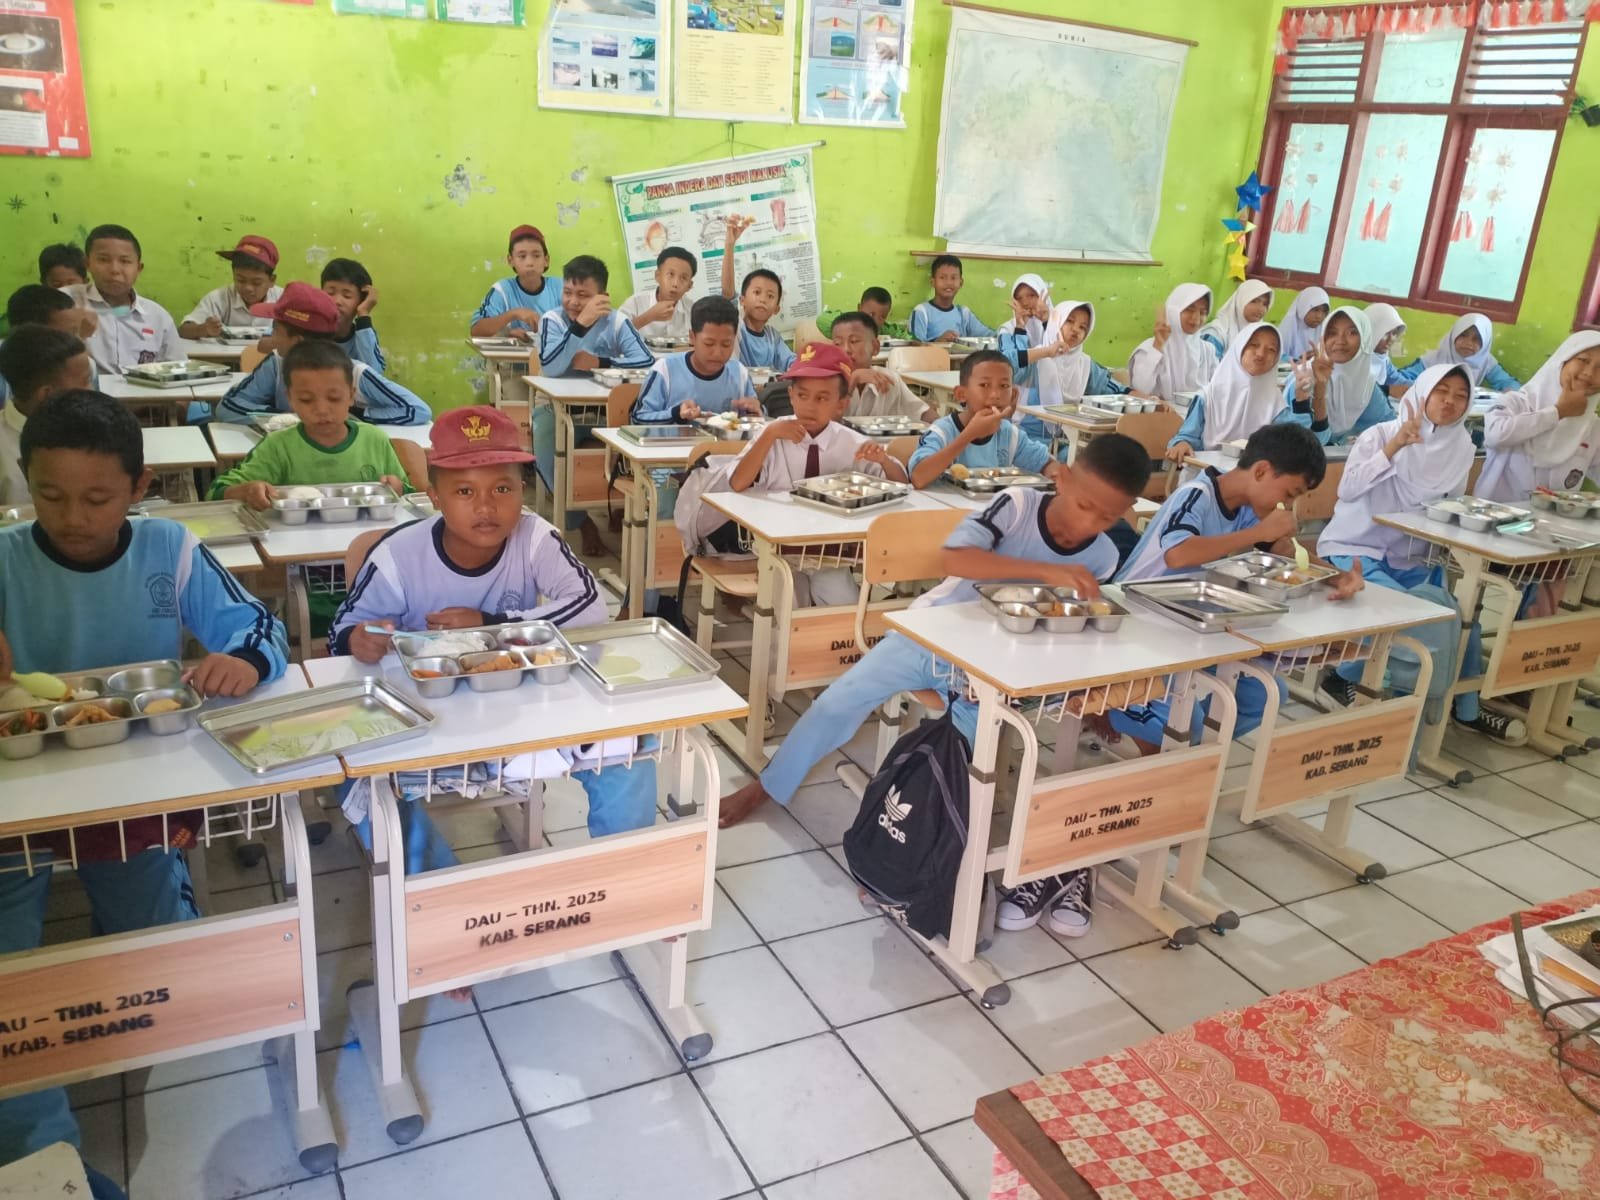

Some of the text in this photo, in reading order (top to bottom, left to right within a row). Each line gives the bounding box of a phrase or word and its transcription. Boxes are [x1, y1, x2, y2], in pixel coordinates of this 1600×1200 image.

[646, 183, 675, 200] PANCA
[675, 178, 705, 194] INDERA
[724, 170, 749, 187] SENDI
[750, 164, 786, 183] MANUSIA
[831, 639, 855, 651] DAU
[1301, 750, 1323, 766] DAU
[1357, 735, 1383, 752] 2025
[1329, 755, 1368, 774] SERANG
[1064, 812, 1088, 828] DAU
[1099, 804, 1123, 818] THN.
[1126, 797, 1154, 812] 2025
[879, 814, 906, 844] aas
[1070, 815, 1140, 842] KAB. SERANG
[465, 911, 502, 931] DAU
[522, 900, 561, 917] THN.
[566, 889, 607, 909] 2025
[479, 911, 592, 948] KAB. SERANG
[54, 1001, 110, 1022] THN.
[115, 987, 171, 1011] 2025
[2, 1014, 155, 1058] KAB. SERANG
